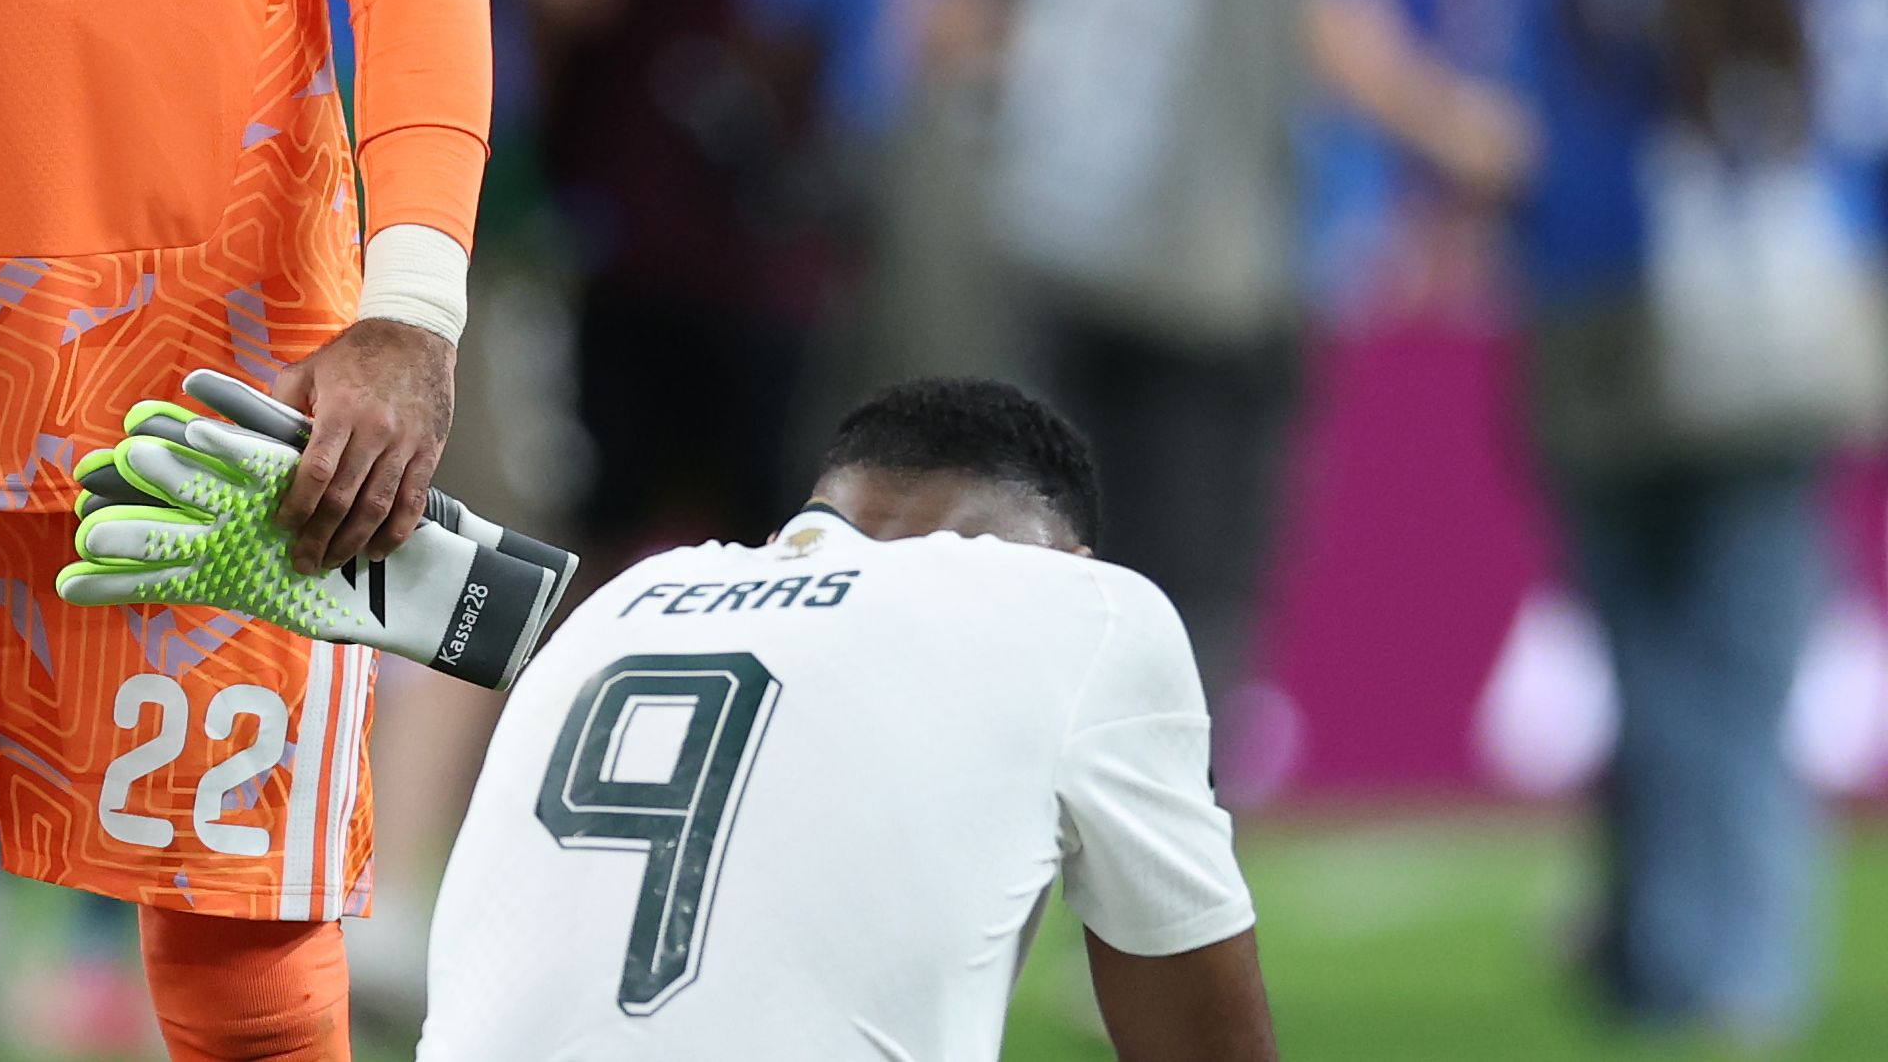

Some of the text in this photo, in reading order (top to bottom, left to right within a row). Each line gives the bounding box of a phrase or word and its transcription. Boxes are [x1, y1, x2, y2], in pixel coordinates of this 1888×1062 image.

[438, 582, 489, 667] Kassar28
[618, 570, 860, 619] FERAS
[98, 674, 290, 857] 22
[534, 652, 783, 1017] 9
